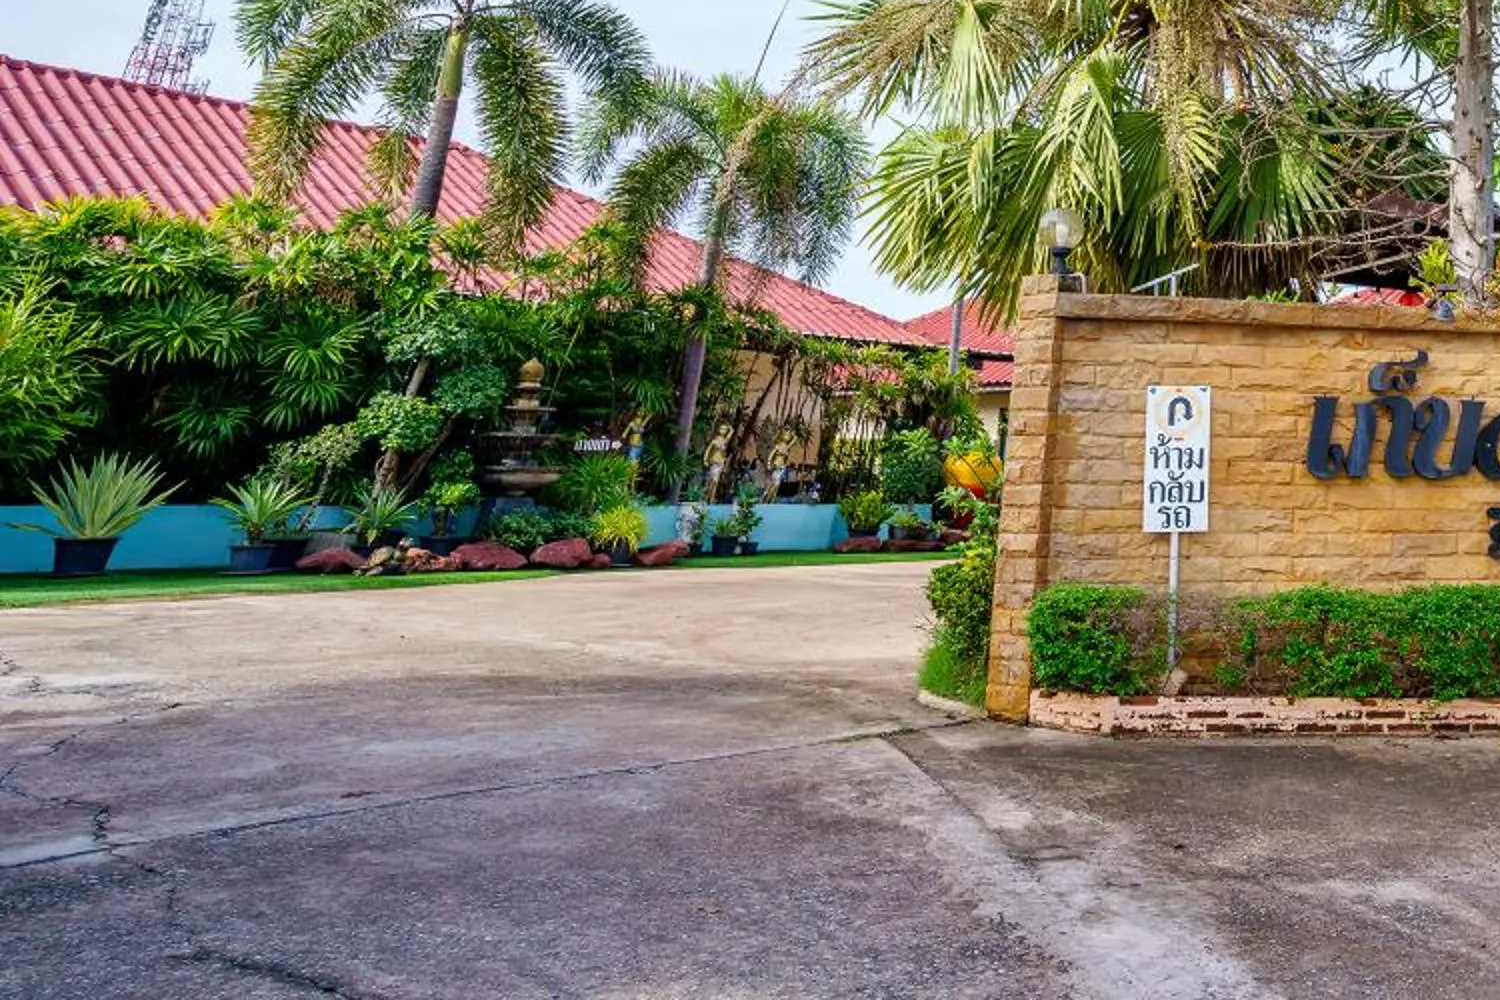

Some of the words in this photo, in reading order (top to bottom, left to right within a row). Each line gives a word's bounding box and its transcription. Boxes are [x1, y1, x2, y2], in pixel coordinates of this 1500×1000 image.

[1150, 434, 1204, 470] ห้าม
[1149, 471, 1204, 504] กลับ
[1158, 505, 1191, 529] รถ
